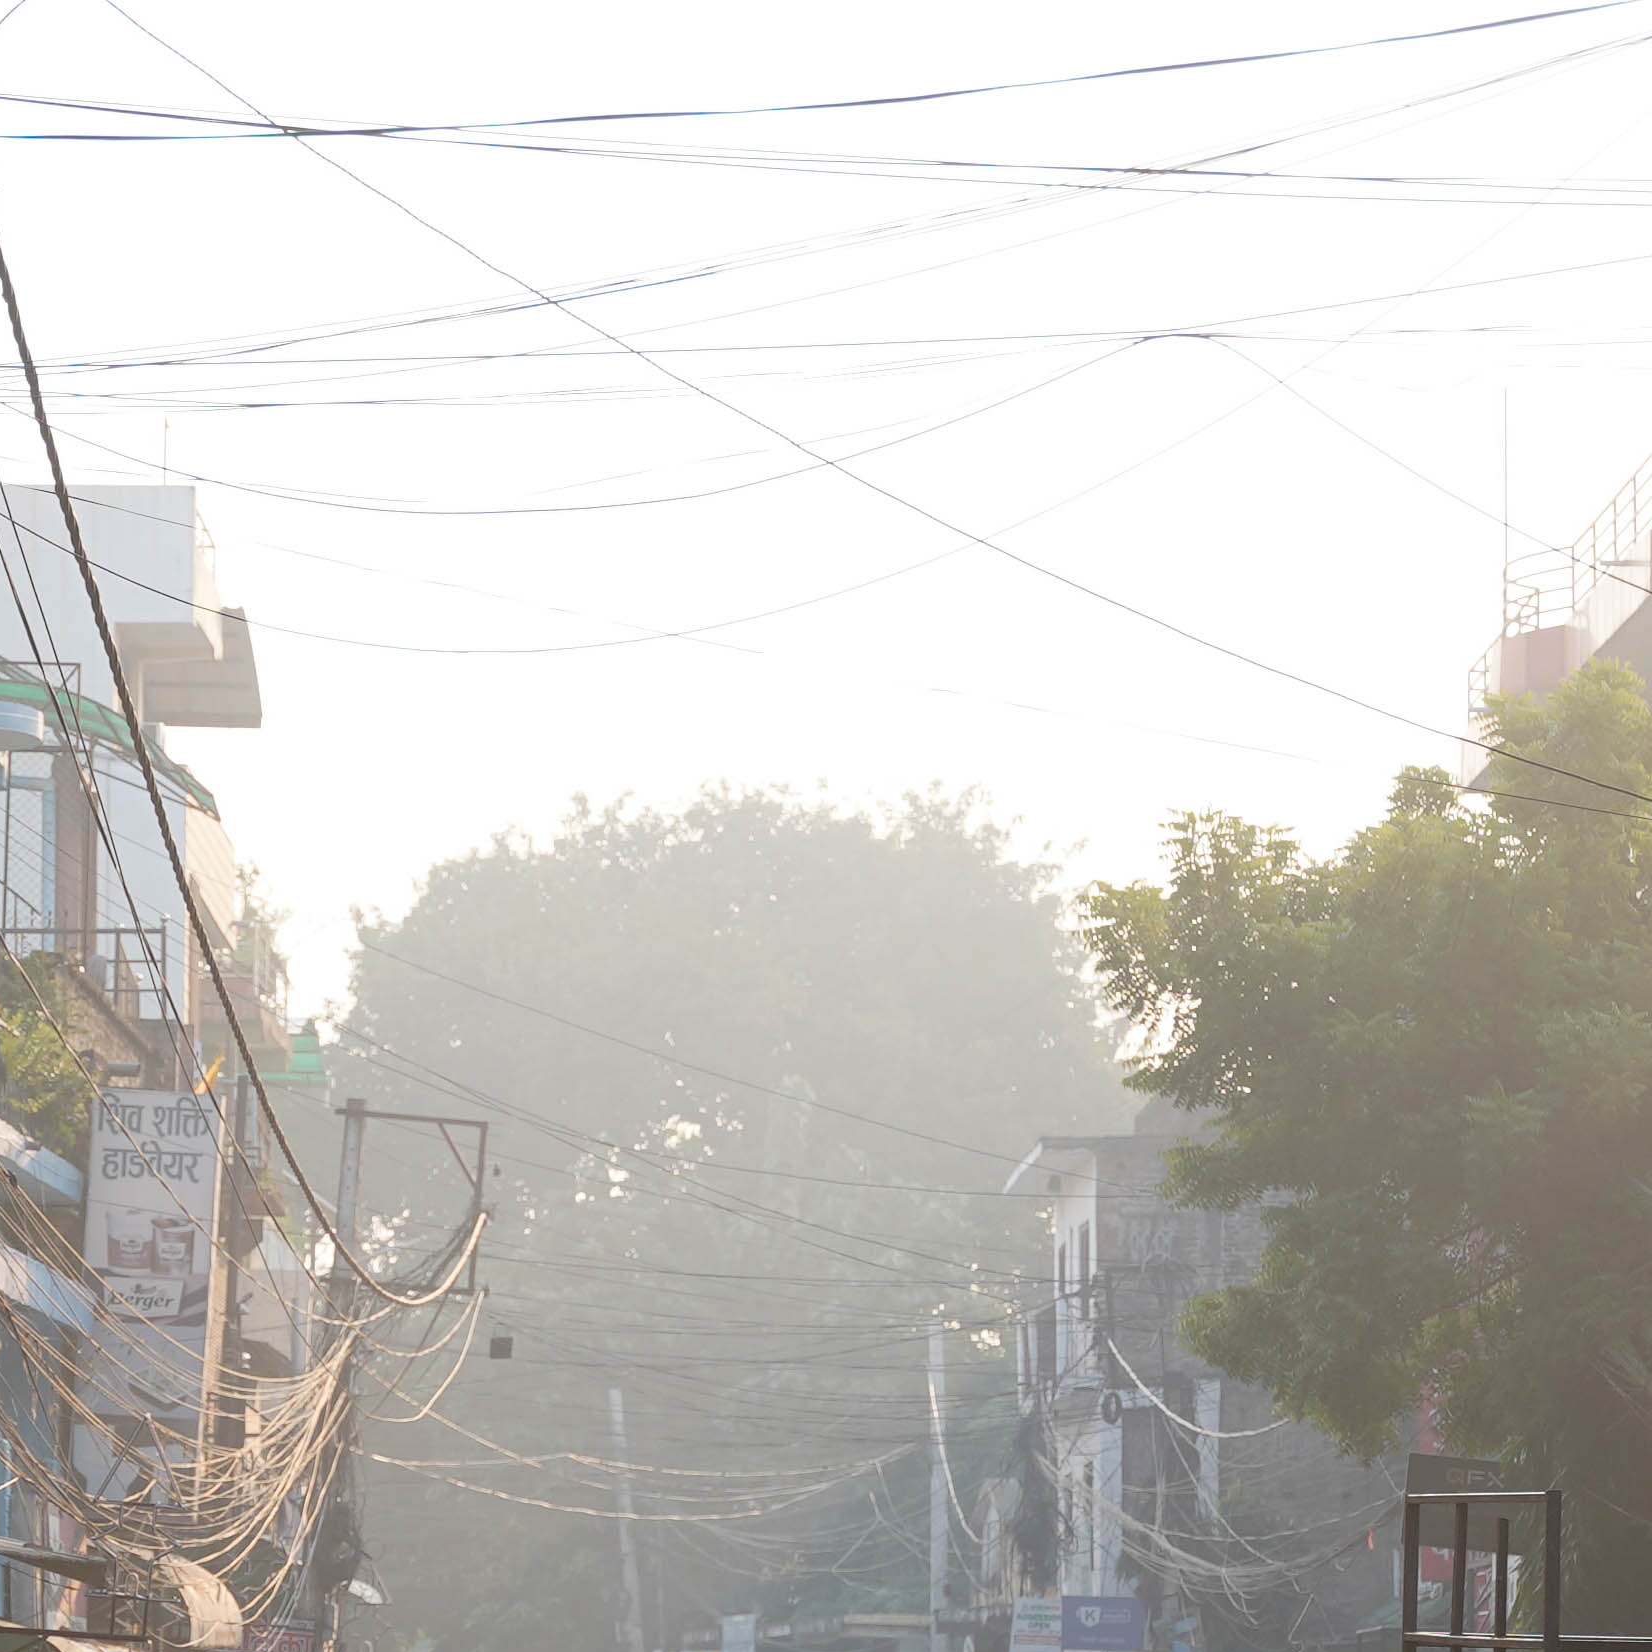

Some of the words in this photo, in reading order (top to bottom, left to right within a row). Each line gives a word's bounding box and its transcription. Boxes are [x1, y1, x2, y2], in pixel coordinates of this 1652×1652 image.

[98, 1093, 144, 1135] शिव
[102, 1140, 203, 1183] हार्डवेयर
[107, 1289, 176, 1312] Berger
